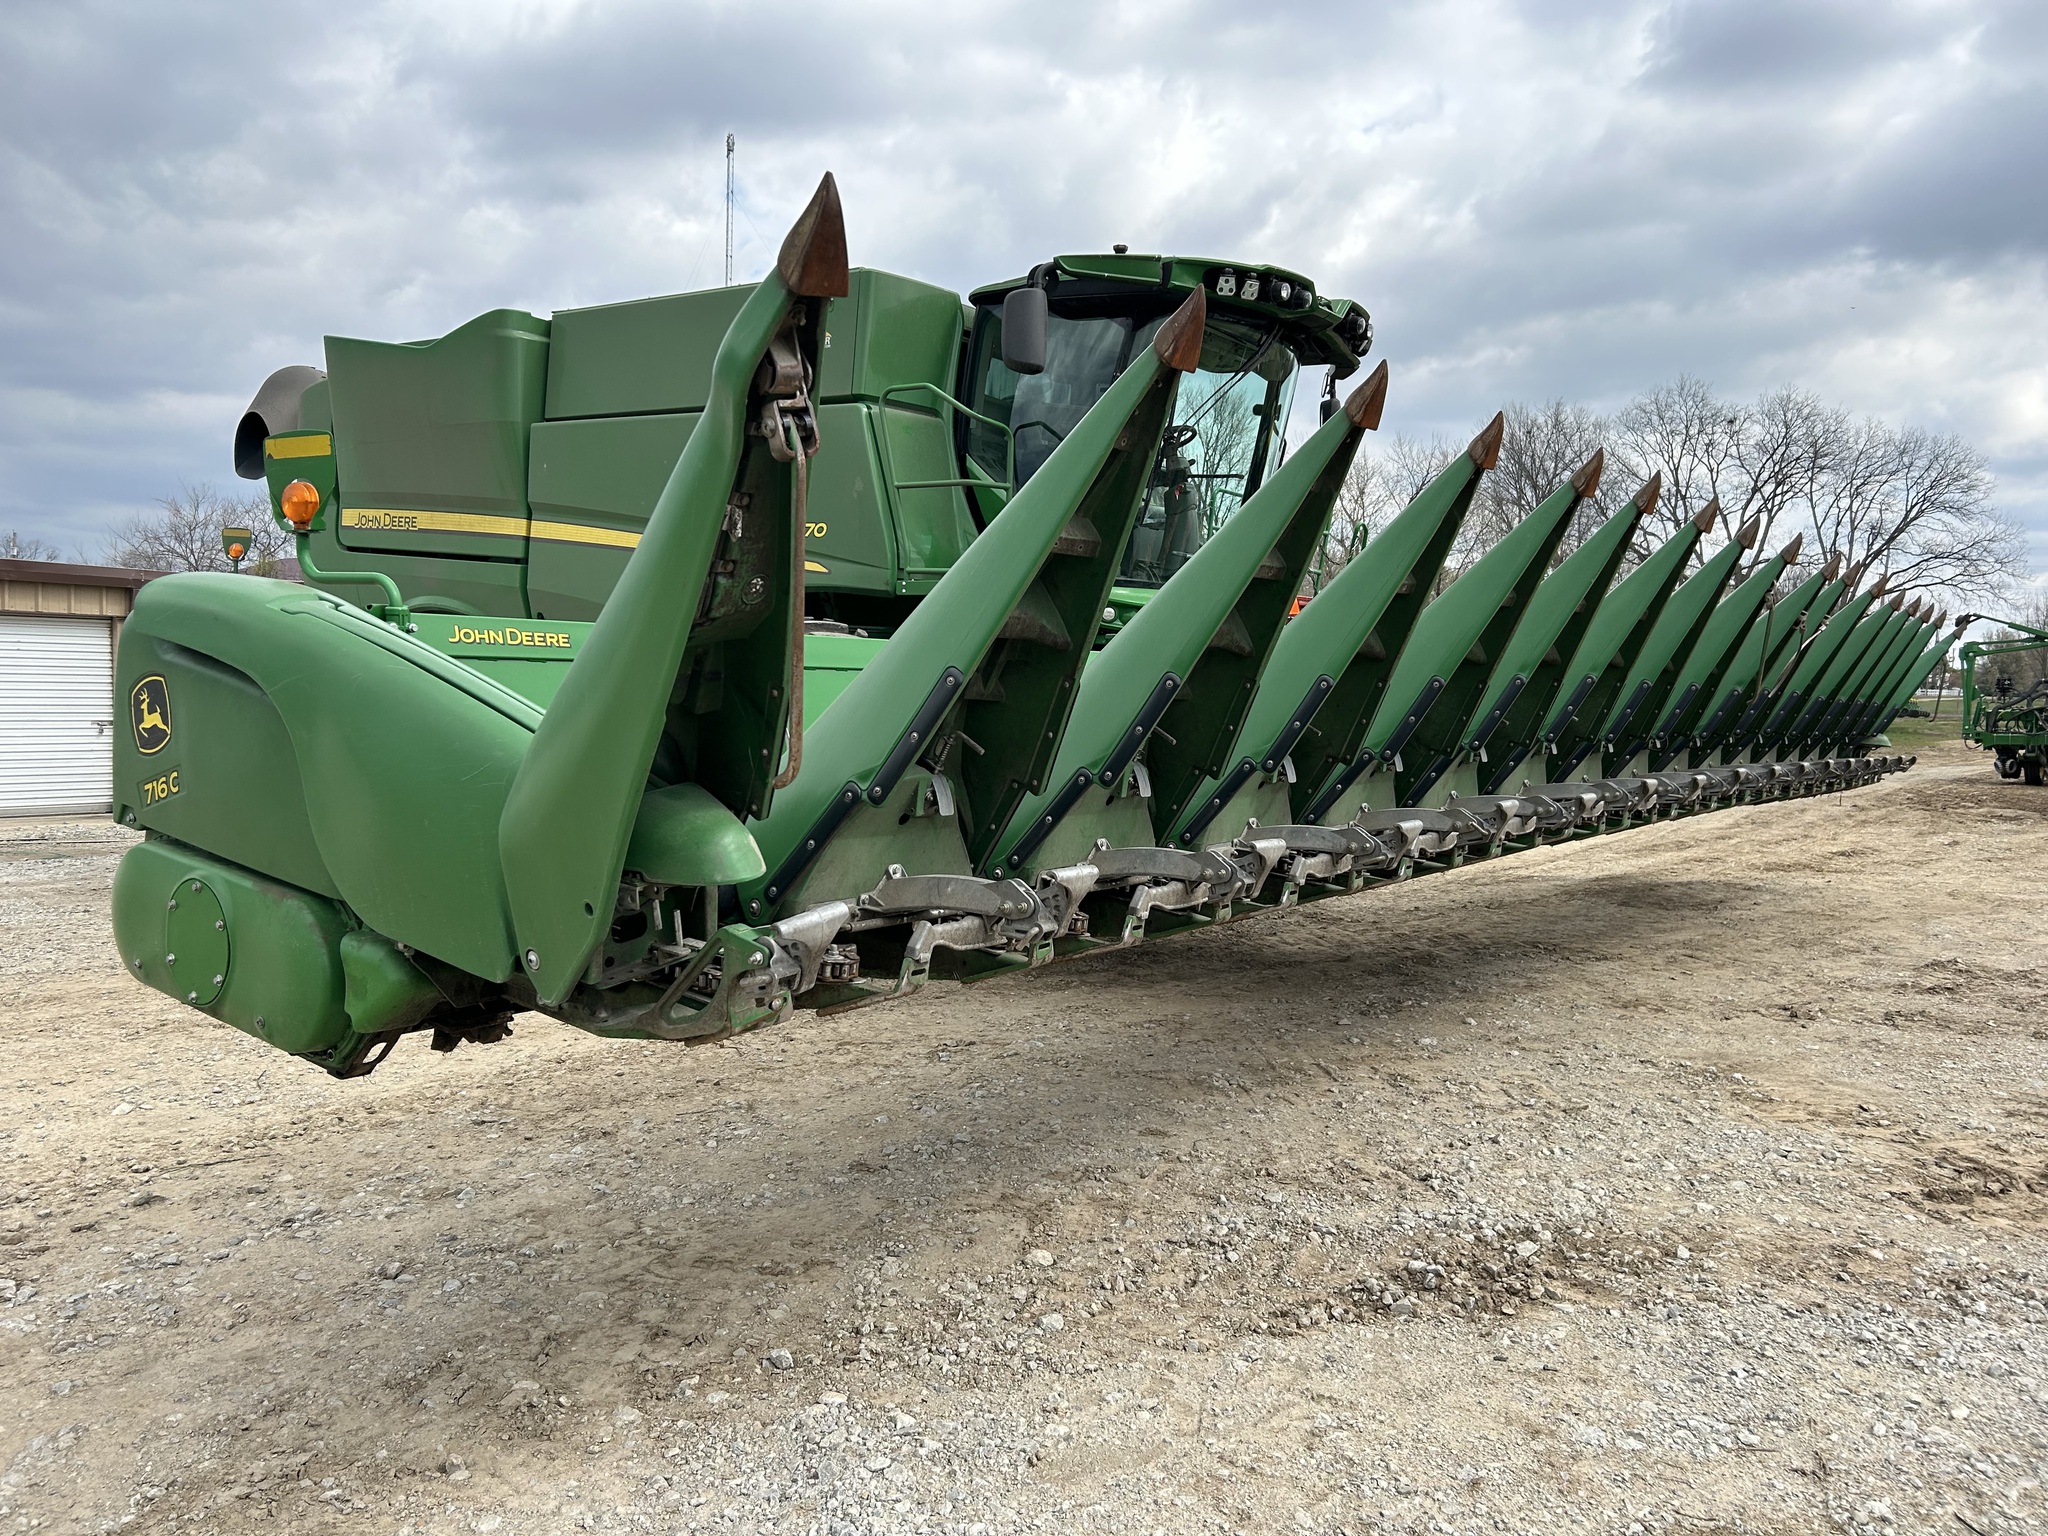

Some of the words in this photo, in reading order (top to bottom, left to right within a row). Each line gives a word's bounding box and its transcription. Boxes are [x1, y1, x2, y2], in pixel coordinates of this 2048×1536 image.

[354, 512, 381, 527] JOHN
[383, 513, 418, 529] DEERE
[448, 625, 504, 645] JOHN
[505, 627, 572, 648] DEERE
